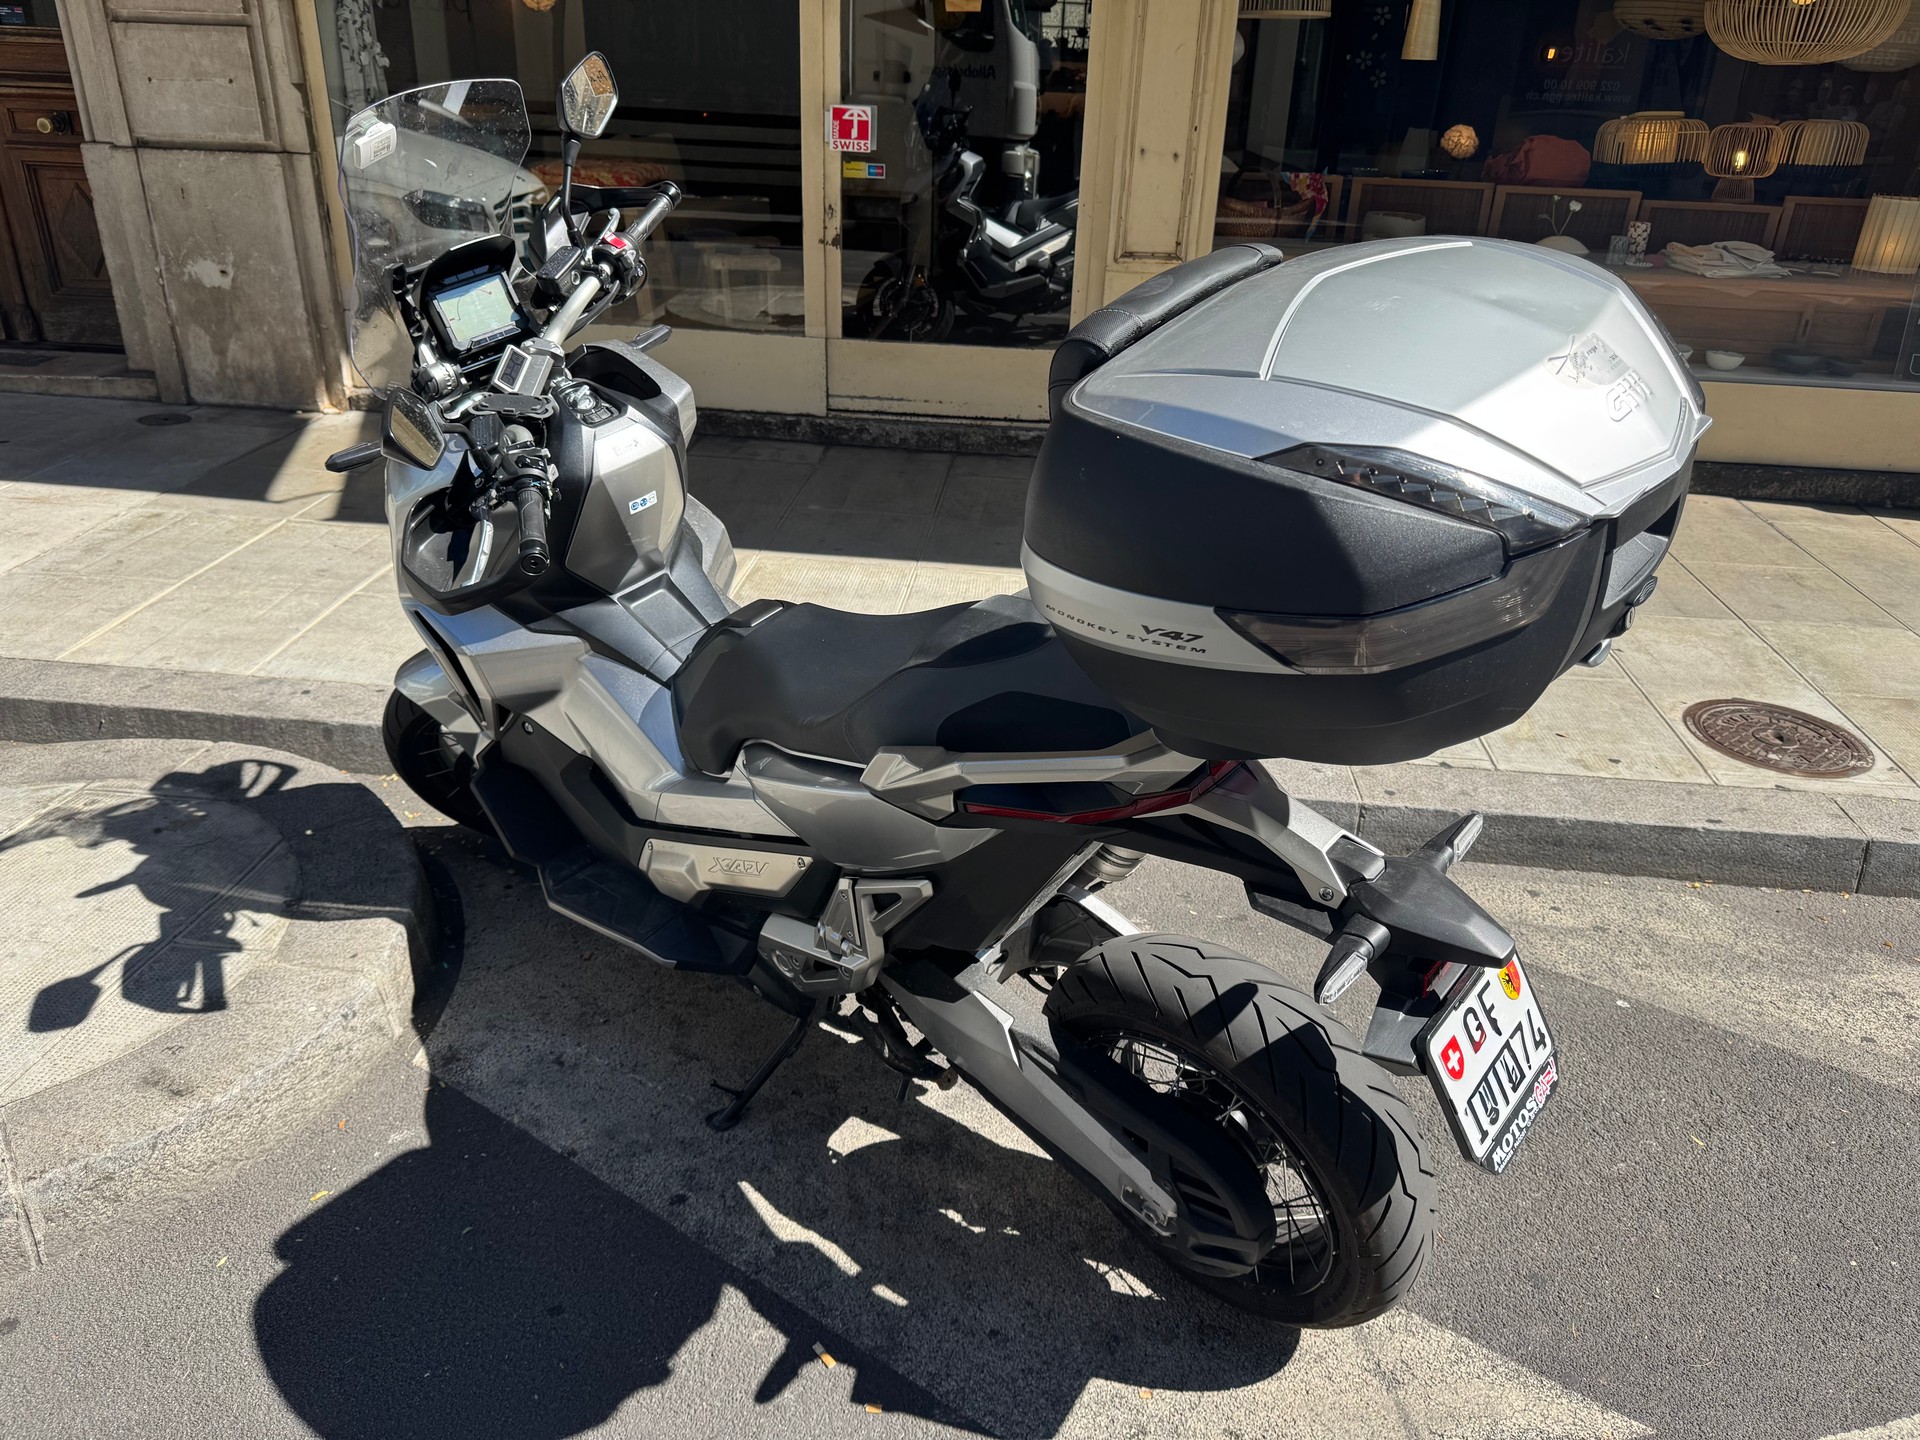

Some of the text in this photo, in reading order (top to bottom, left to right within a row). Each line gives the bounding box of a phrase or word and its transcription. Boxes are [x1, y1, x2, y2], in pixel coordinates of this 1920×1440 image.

[832, 140, 869, 152] SWISS
[1045, 603, 1206, 654] MONOKEY SYSTEM
[1141, 624, 1204, 643] V47
[1492, 1096, 1537, 1173] MOTOS
